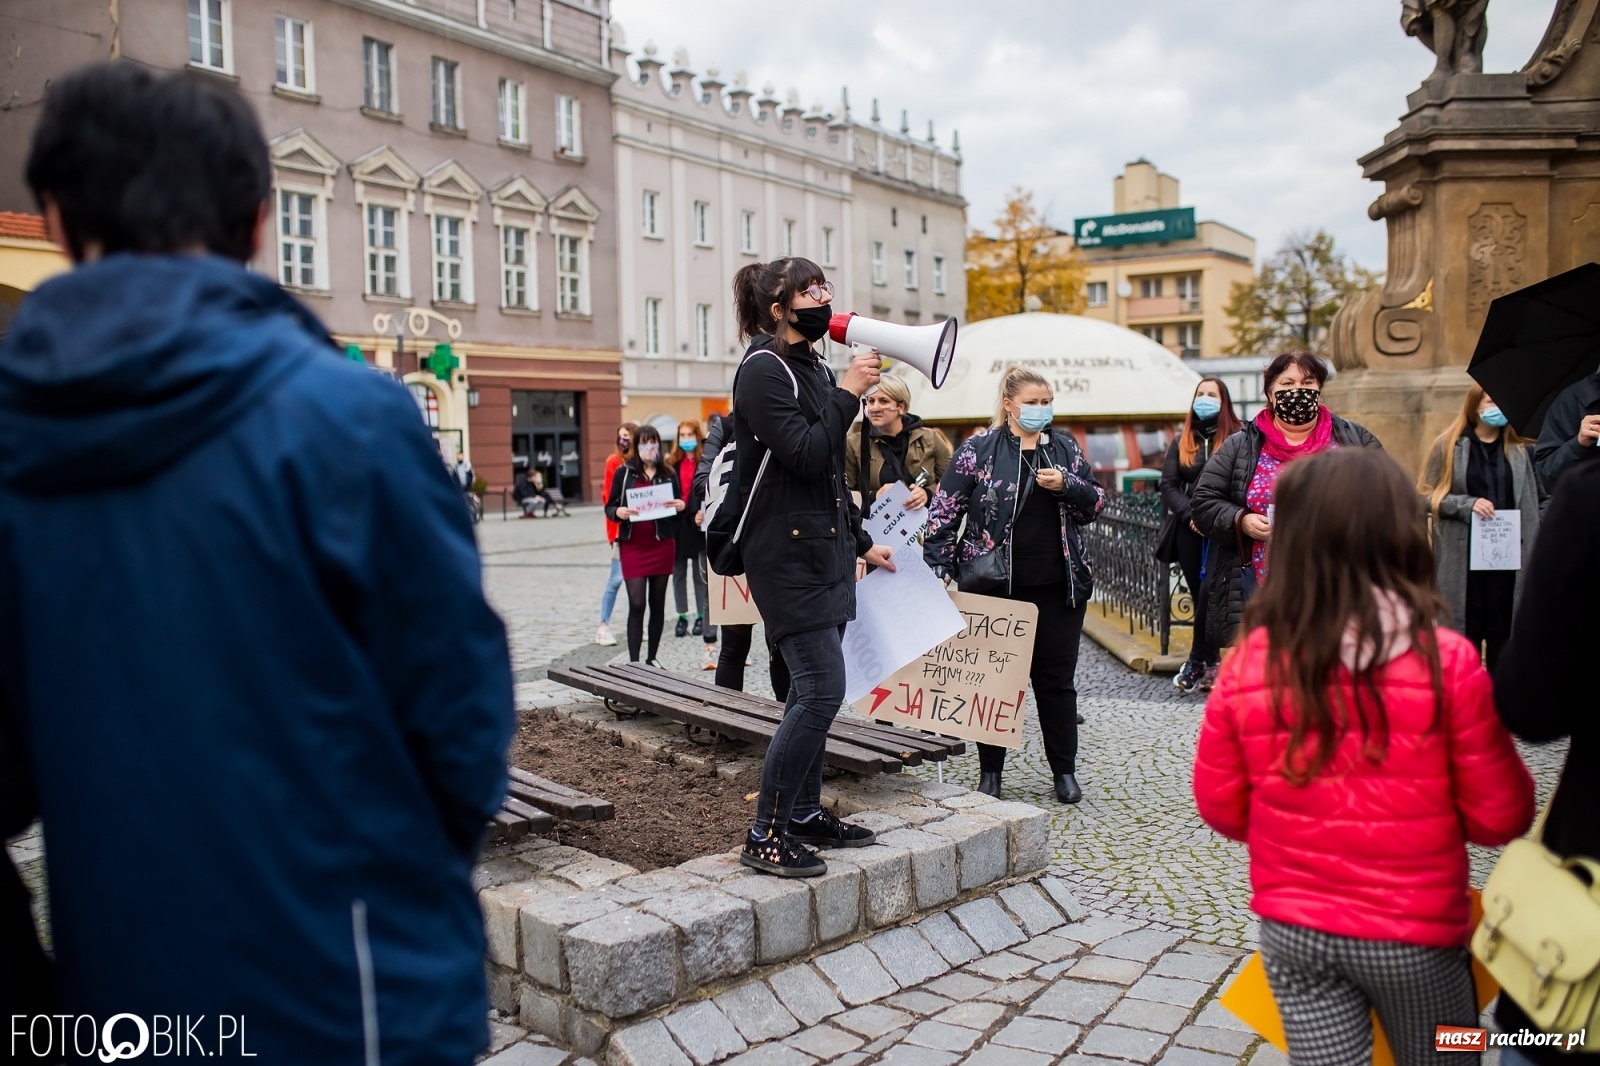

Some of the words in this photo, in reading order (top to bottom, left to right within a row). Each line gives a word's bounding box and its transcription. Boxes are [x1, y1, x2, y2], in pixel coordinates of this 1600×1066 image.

[1102, 220, 1166, 237] McDonald's
[957, 610, 1031, 640] TACIE
[922, 641, 980, 666] ZYŃSKI
[922, 662, 963, 687] FAJNY
[894, 682, 924, 720] JA
[930, 688, 968, 725] TEŻ
[967, 690, 1026, 734] NIE!
